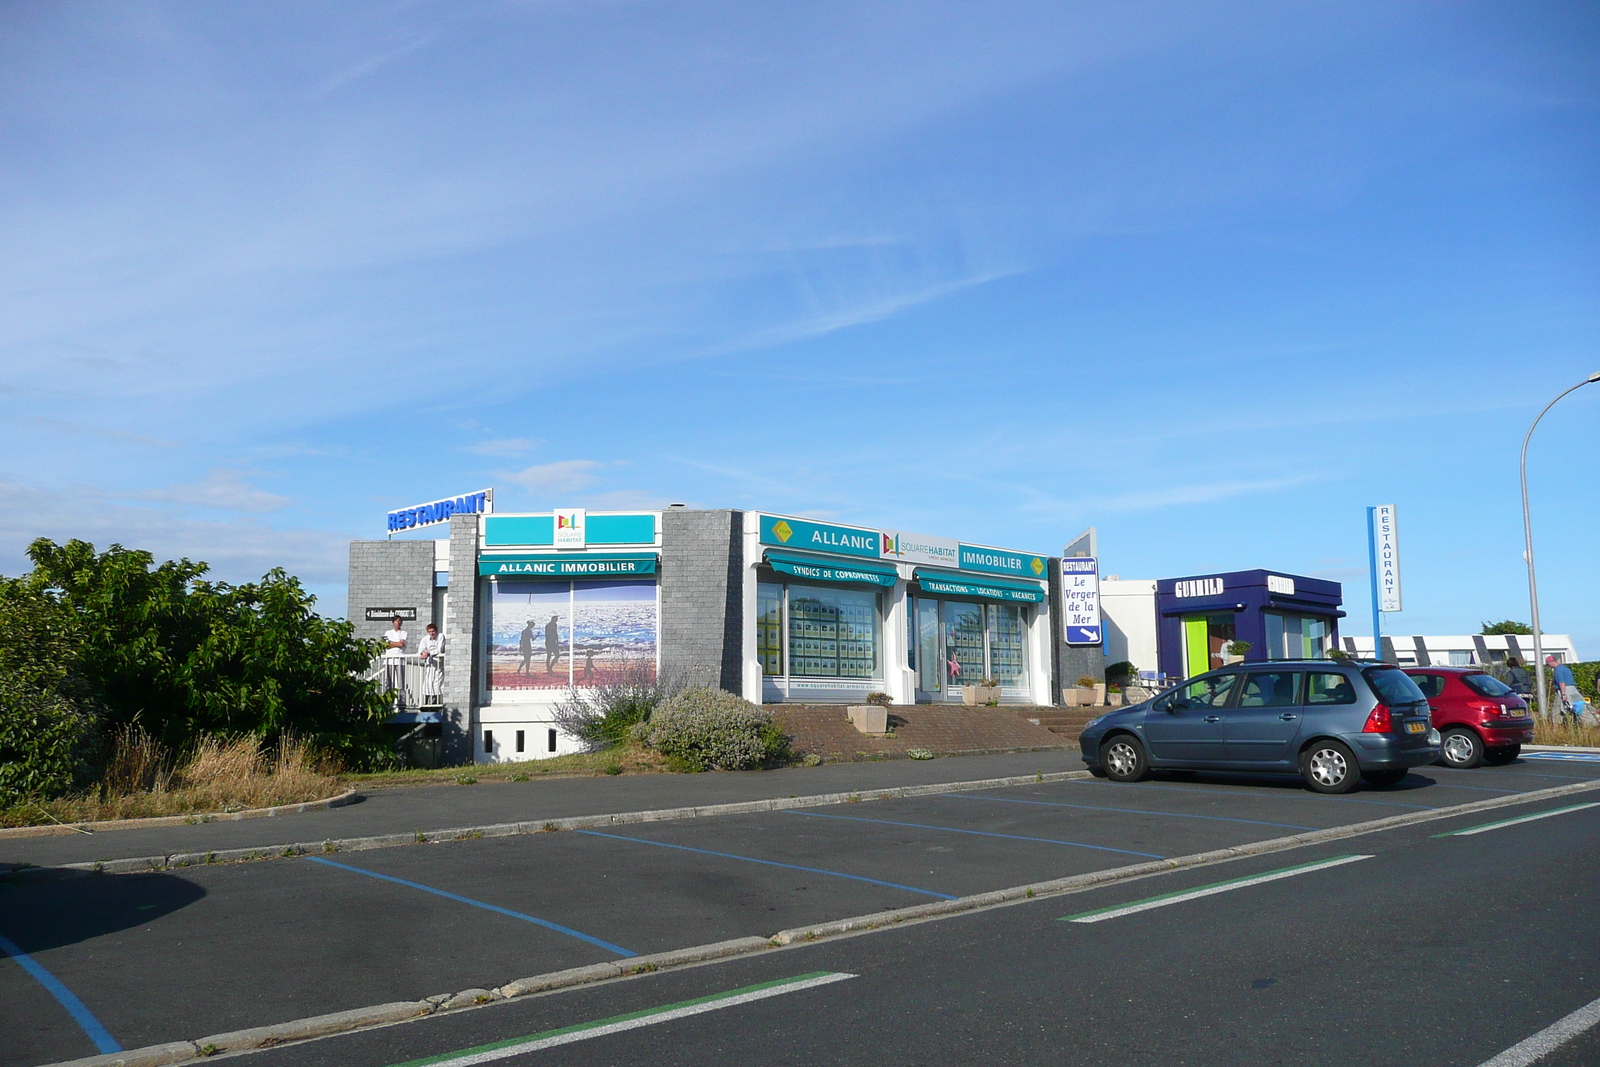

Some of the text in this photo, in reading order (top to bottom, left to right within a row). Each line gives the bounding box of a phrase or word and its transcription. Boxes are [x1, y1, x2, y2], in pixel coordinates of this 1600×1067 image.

[388, 492, 486, 532] RESTAURANT
[812, 530, 874, 550] ALLANIC
[1381, 507, 1394, 594] RESTAURANT
[498, 562, 636, 573] ALLANIC IMMOBILIER
[963, 552, 1022, 570] IMMOBILIER
[1063, 561, 1095, 572] RESTAURANT
[793, 566, 820, 577] SYNDICS
[835, 571, 880, 583] COPROPRIETES
[1074, 577, 1086, 587] Le
[929, 582, 968, 593] TRANSACTIONS
[977, 587, 1003, 598] LOCATIONS
[1011, 591, 1036, 601] VACANCES
[1065, 589, 1096, 601] Verger
[1175, 578, 1224, 598] GUNHILD
[1069, 602, 1094, 611] de la
[1073, 614, 1092, 624] Mer
